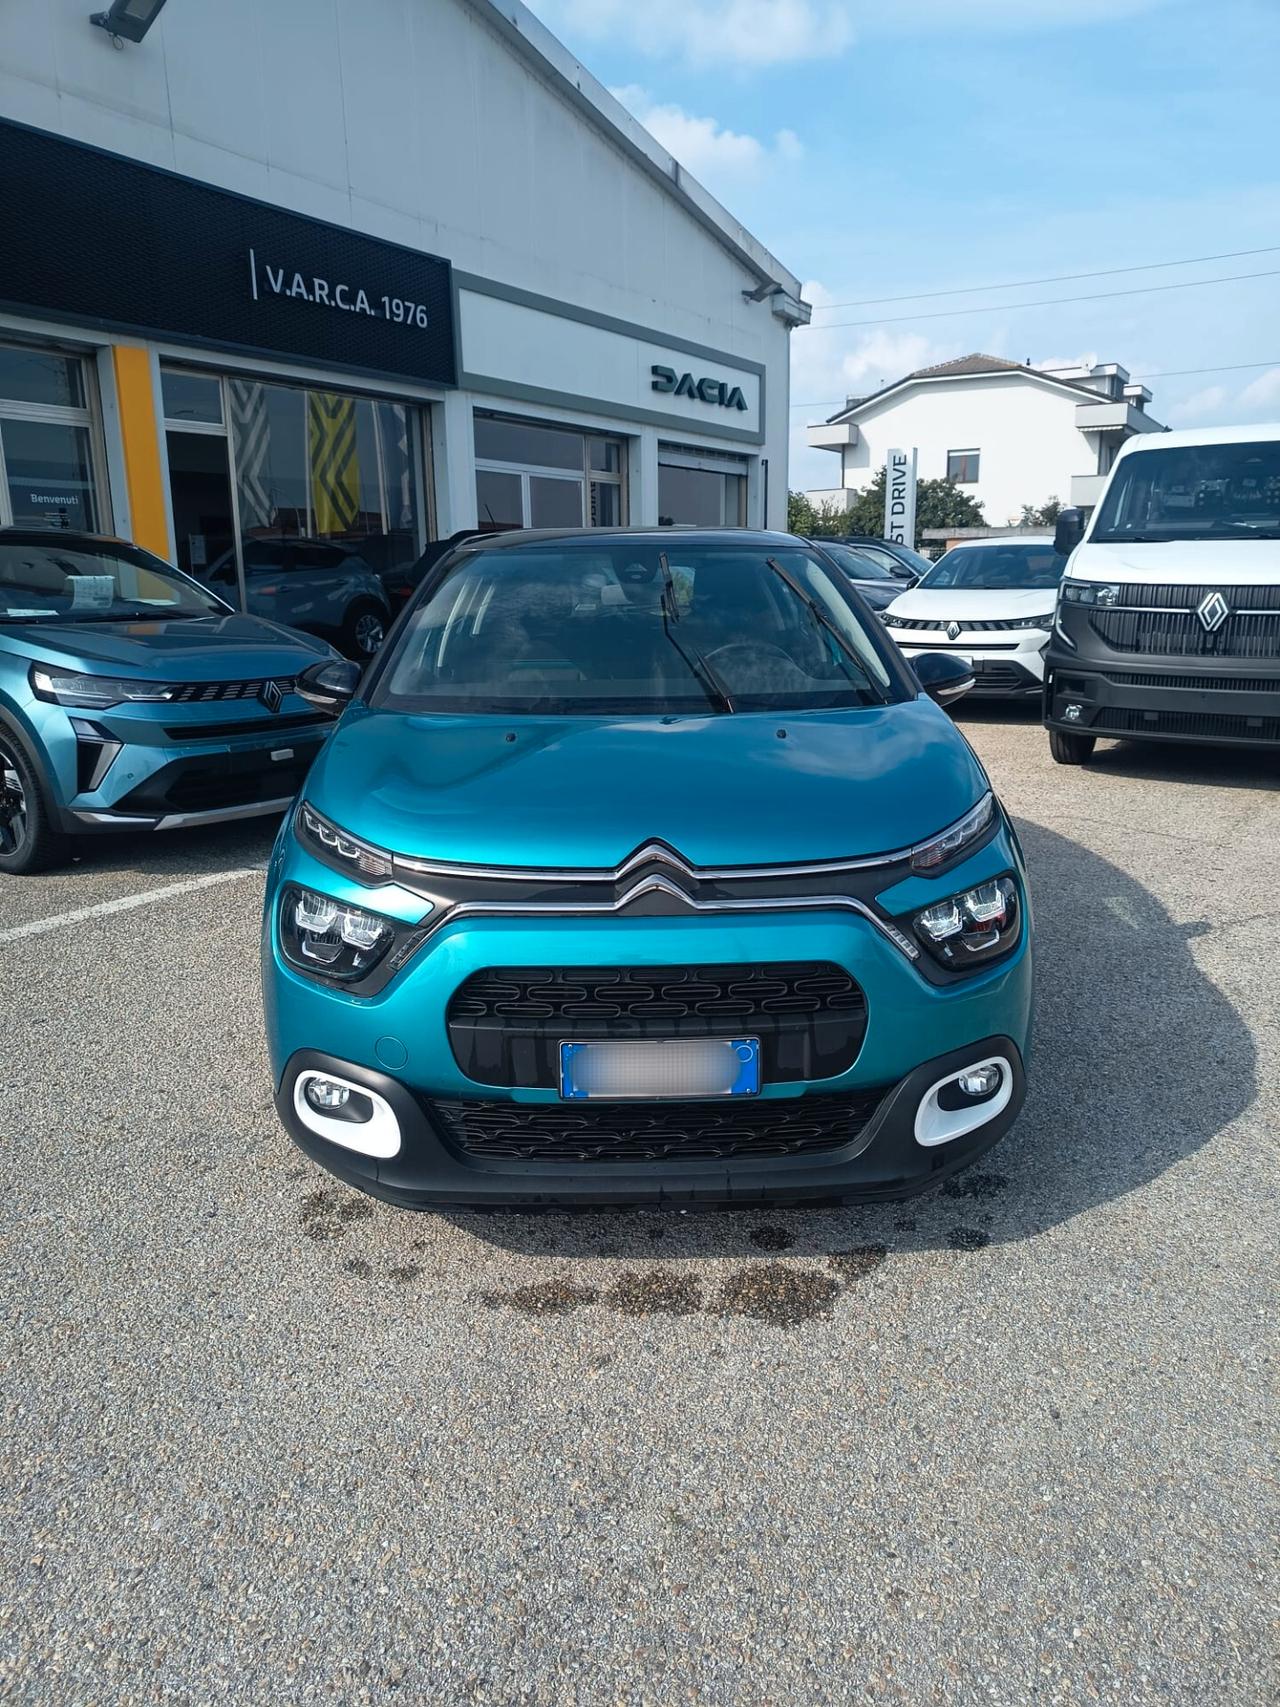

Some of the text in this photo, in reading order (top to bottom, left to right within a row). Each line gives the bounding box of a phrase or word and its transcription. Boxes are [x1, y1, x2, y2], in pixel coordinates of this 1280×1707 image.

[265, 265, 428, 328] V.A.R.C.A. 1976
[651, 365, 748, 411] DACIA
[30, 493, 79, 504] Benvenuti
[891, 454, 907, 516] DRIVE
